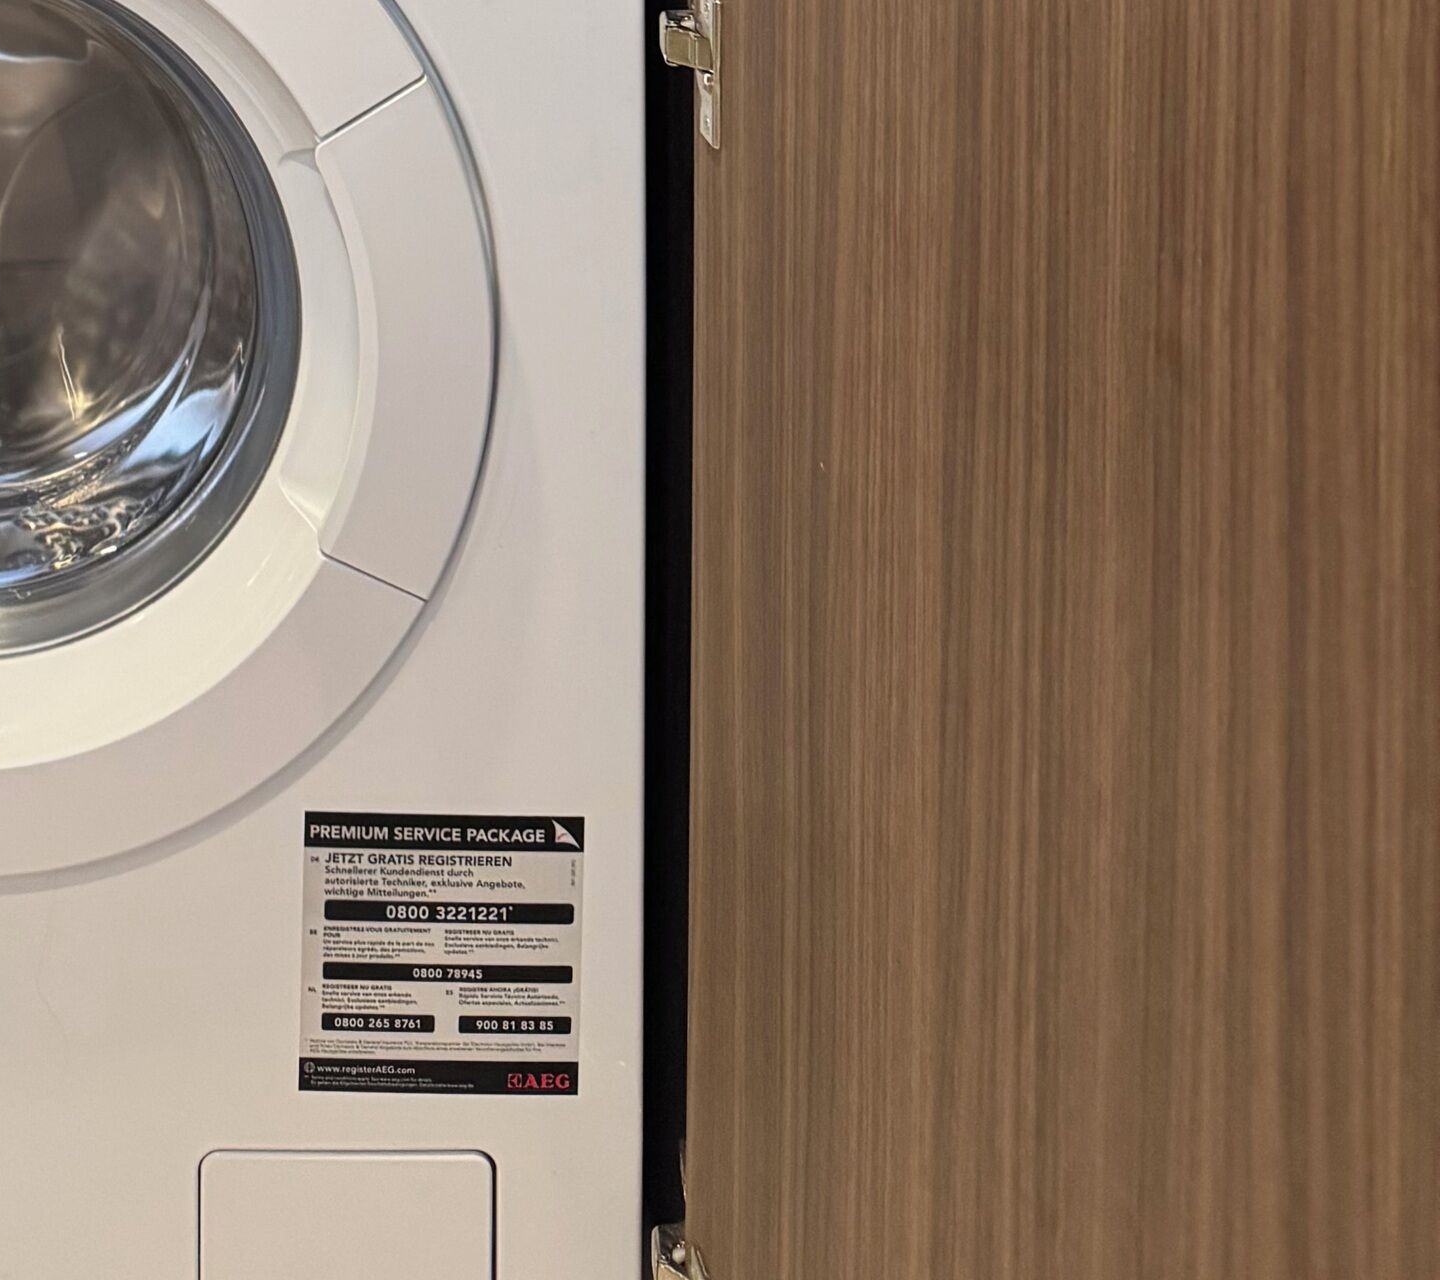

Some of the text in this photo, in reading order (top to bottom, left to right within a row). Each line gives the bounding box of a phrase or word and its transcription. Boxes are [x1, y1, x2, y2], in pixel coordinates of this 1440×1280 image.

[310, 825, 545, 843] PREMIUM SERVICE PACKAGE
[325, 853, 364, 864] JETZT
[368, 854, 414, 865] GRATIS
[419, 855, 512, 867] REGISTRIEREN
[325, 866, 474, 877] Schnellerer Kundendienst durch
[325, 877, 378, 886] autorisierte
[431, 878, 473, 888] exklusive
[324, 888, 364, 898] wichtige
[386, 906, 429, 919] 0800
[413, 968, 483, 979] 0800 78945
[334, 1018, 421, 1029] 0800 265 8761
[476, 1020, 554, 1031] 900 81 83 85
[317, 1064, 415, 1075] www.registerAEG.com
[524, 1074, 570, 1089] AEG
